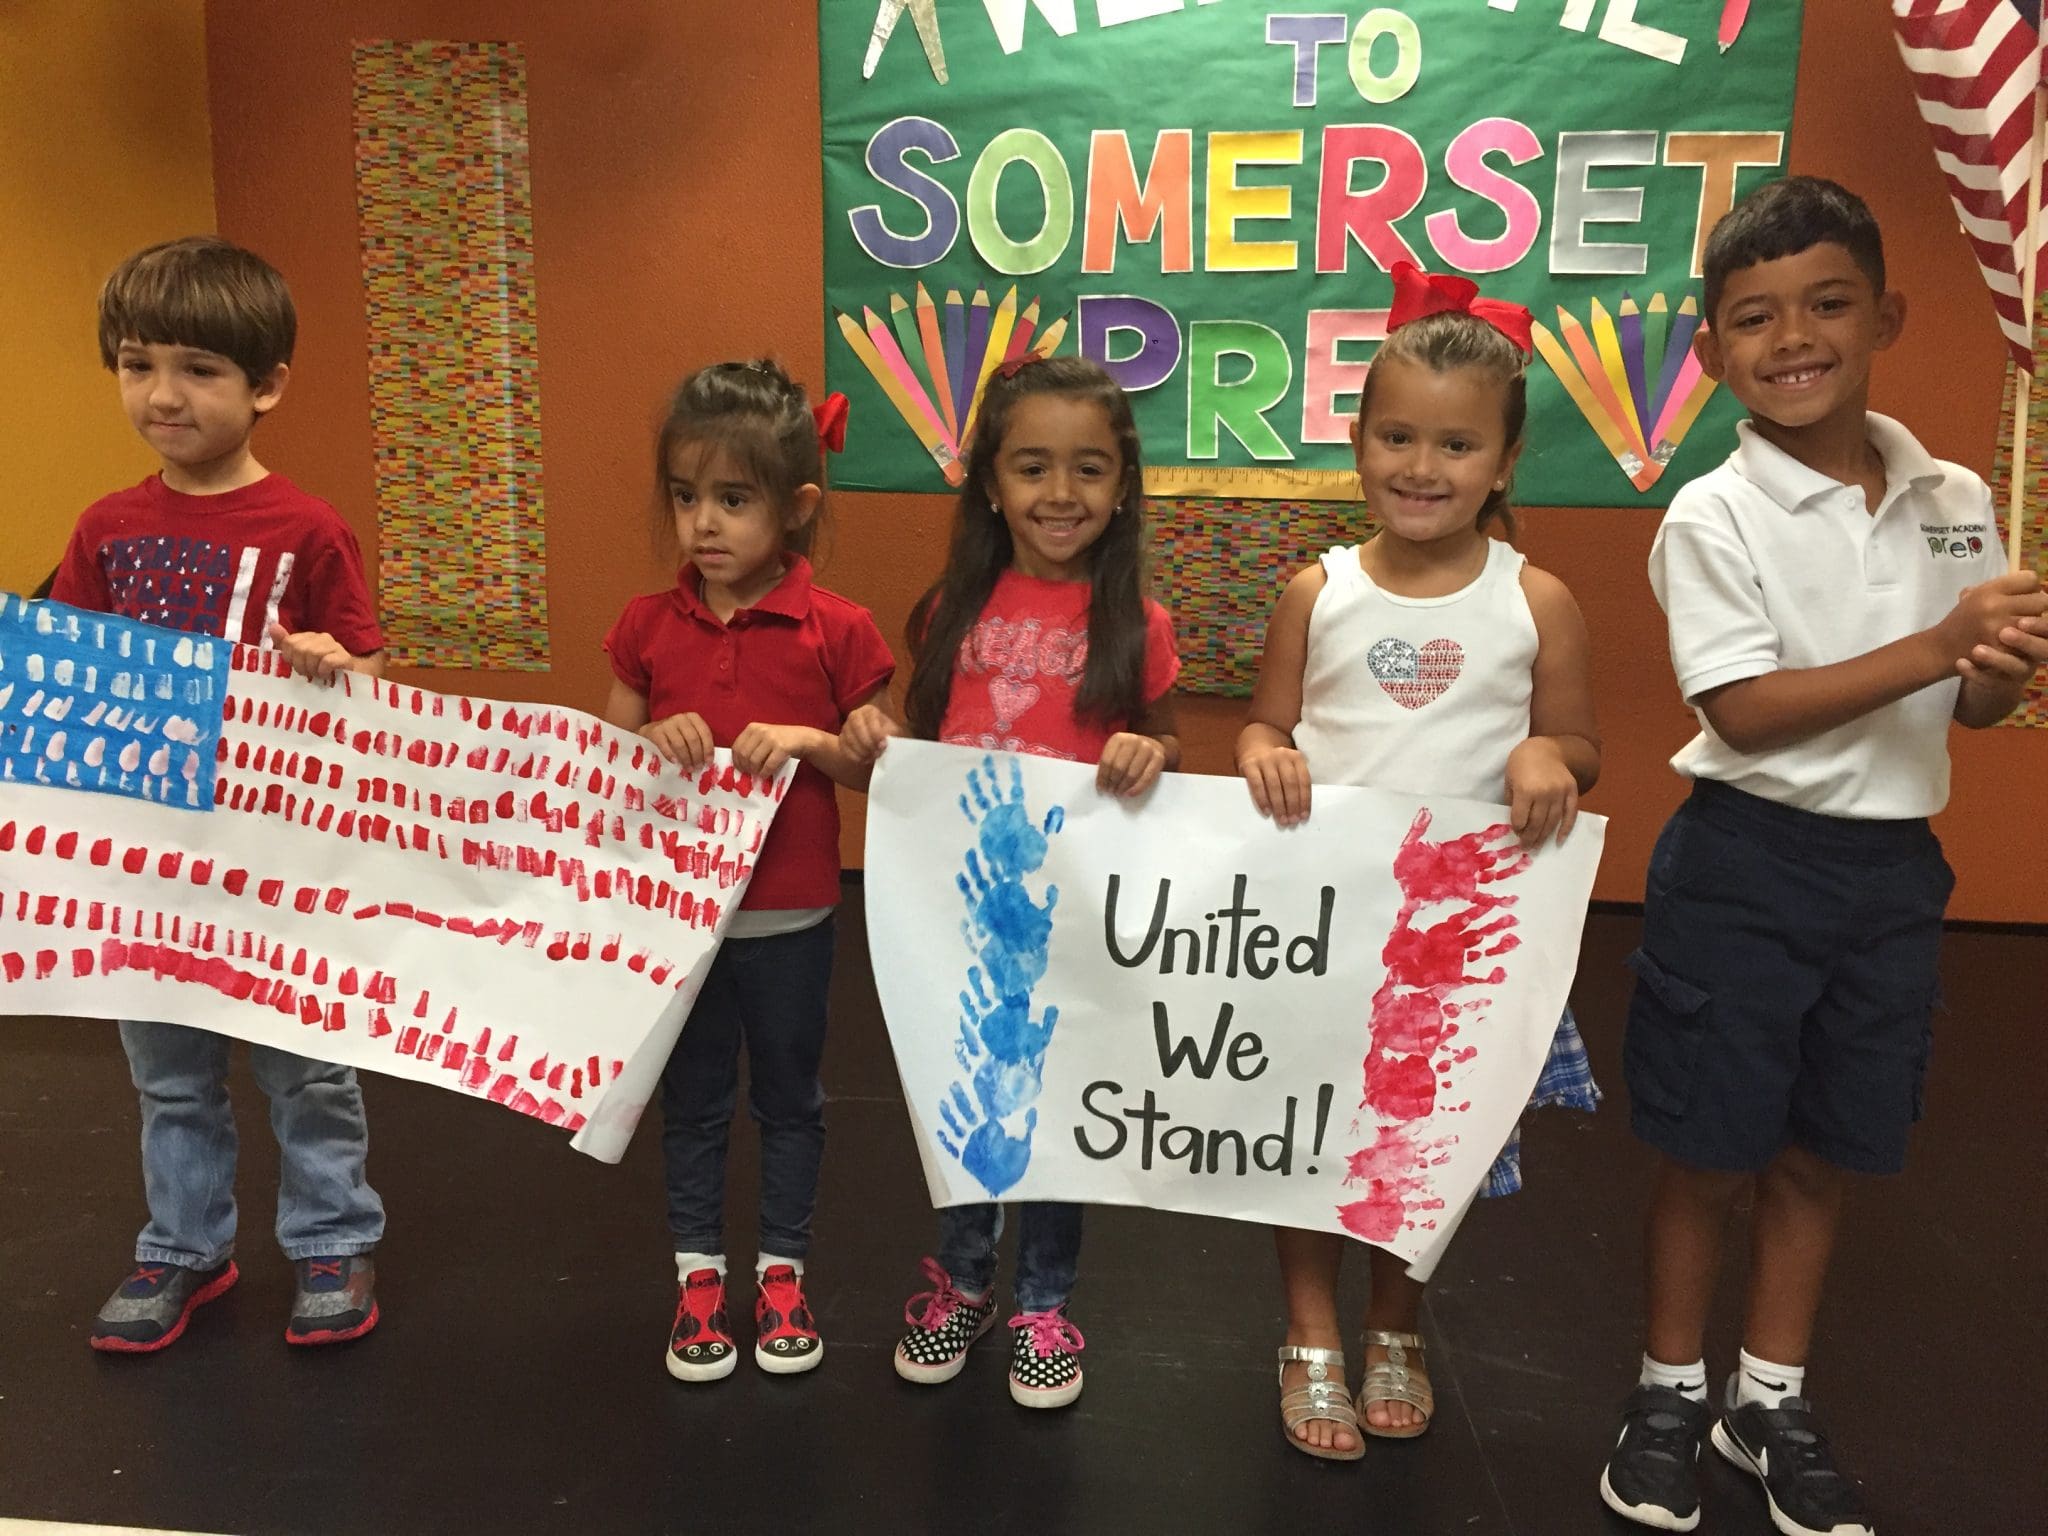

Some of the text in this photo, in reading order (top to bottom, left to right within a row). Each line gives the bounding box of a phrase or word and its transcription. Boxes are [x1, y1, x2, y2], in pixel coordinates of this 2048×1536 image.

[1265, 7, 1422, 107] TO
[848, 116, 1784, 278] SOMERSET
[1926, 535, 1983, 559] prep
[1104, 873, 1336, 980] United
[1152, 1001, 1269, 1082] We
[1074, 1080, 1335, 1177] Stand!
